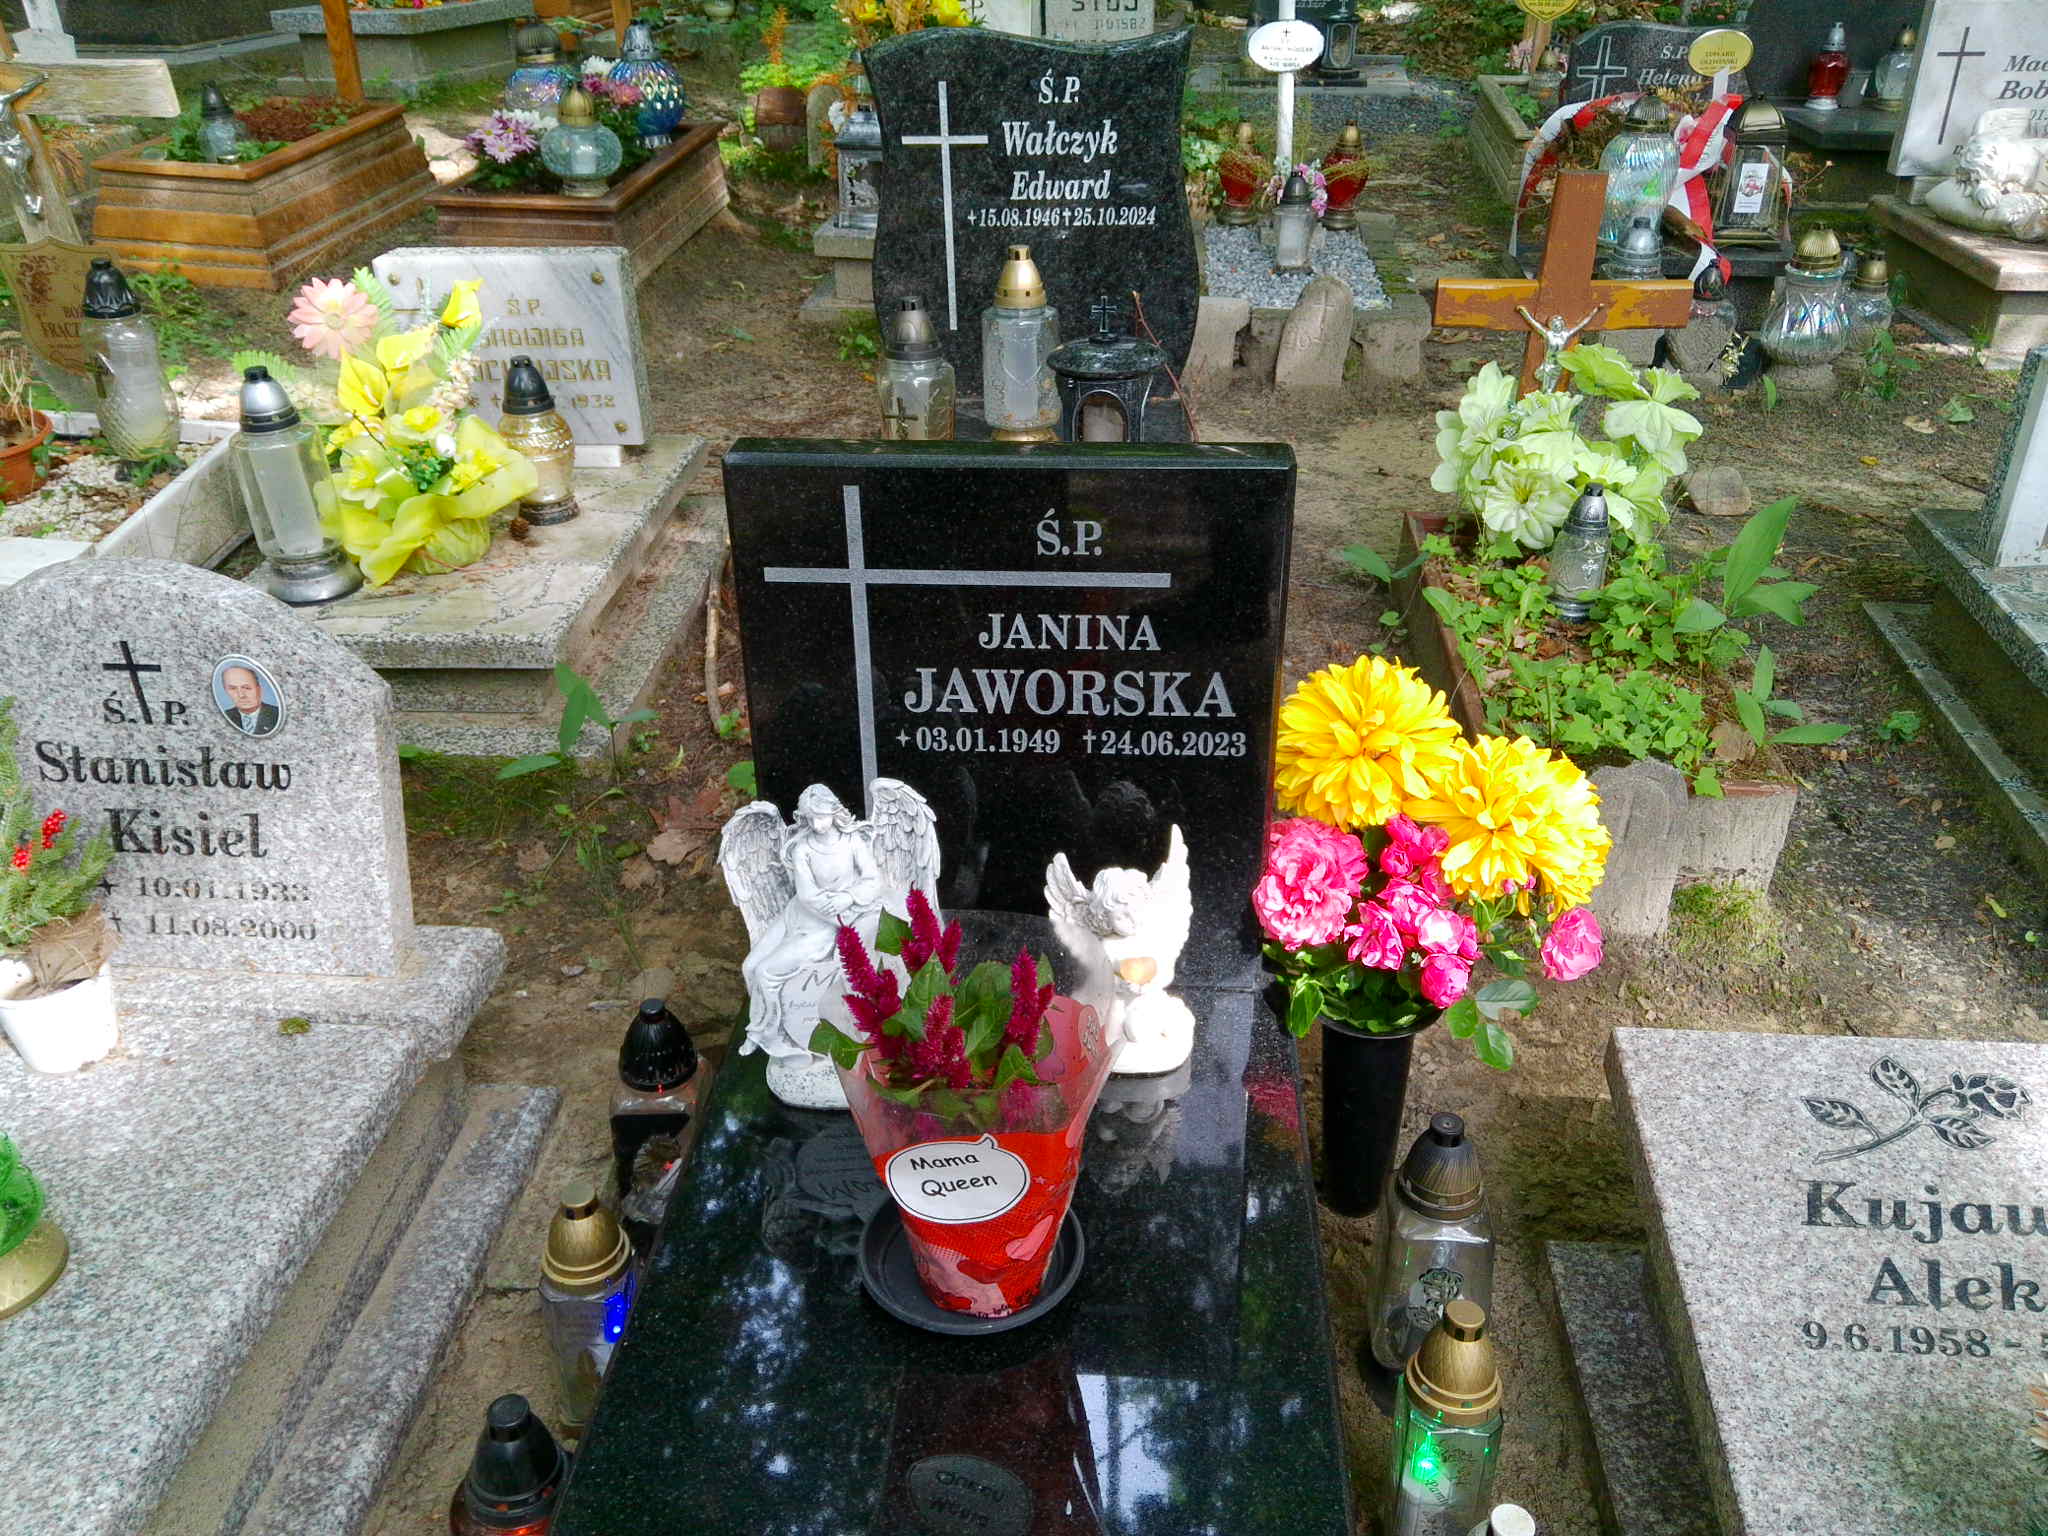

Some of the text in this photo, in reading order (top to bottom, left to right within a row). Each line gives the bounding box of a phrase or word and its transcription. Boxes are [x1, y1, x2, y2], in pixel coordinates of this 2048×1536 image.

[1002, 119, 1118, 163] Wałczyk
[1010, 169, 1112, 200] Edward
[1037, 508, 1102, 556] Ś.P.
[978, 613, 1161, 651] JANINA
[904, 667, 1237, 717] JAWORSKA
[35, 740, 291, 791] Stanisław
[104, 808, 268, 858] Kisiel
[910, 1154, 980, 1170] Mama
[921, 1175, 998, 1197] Queen
[1801, 1321, 1991, 1357] 9.6.1958
